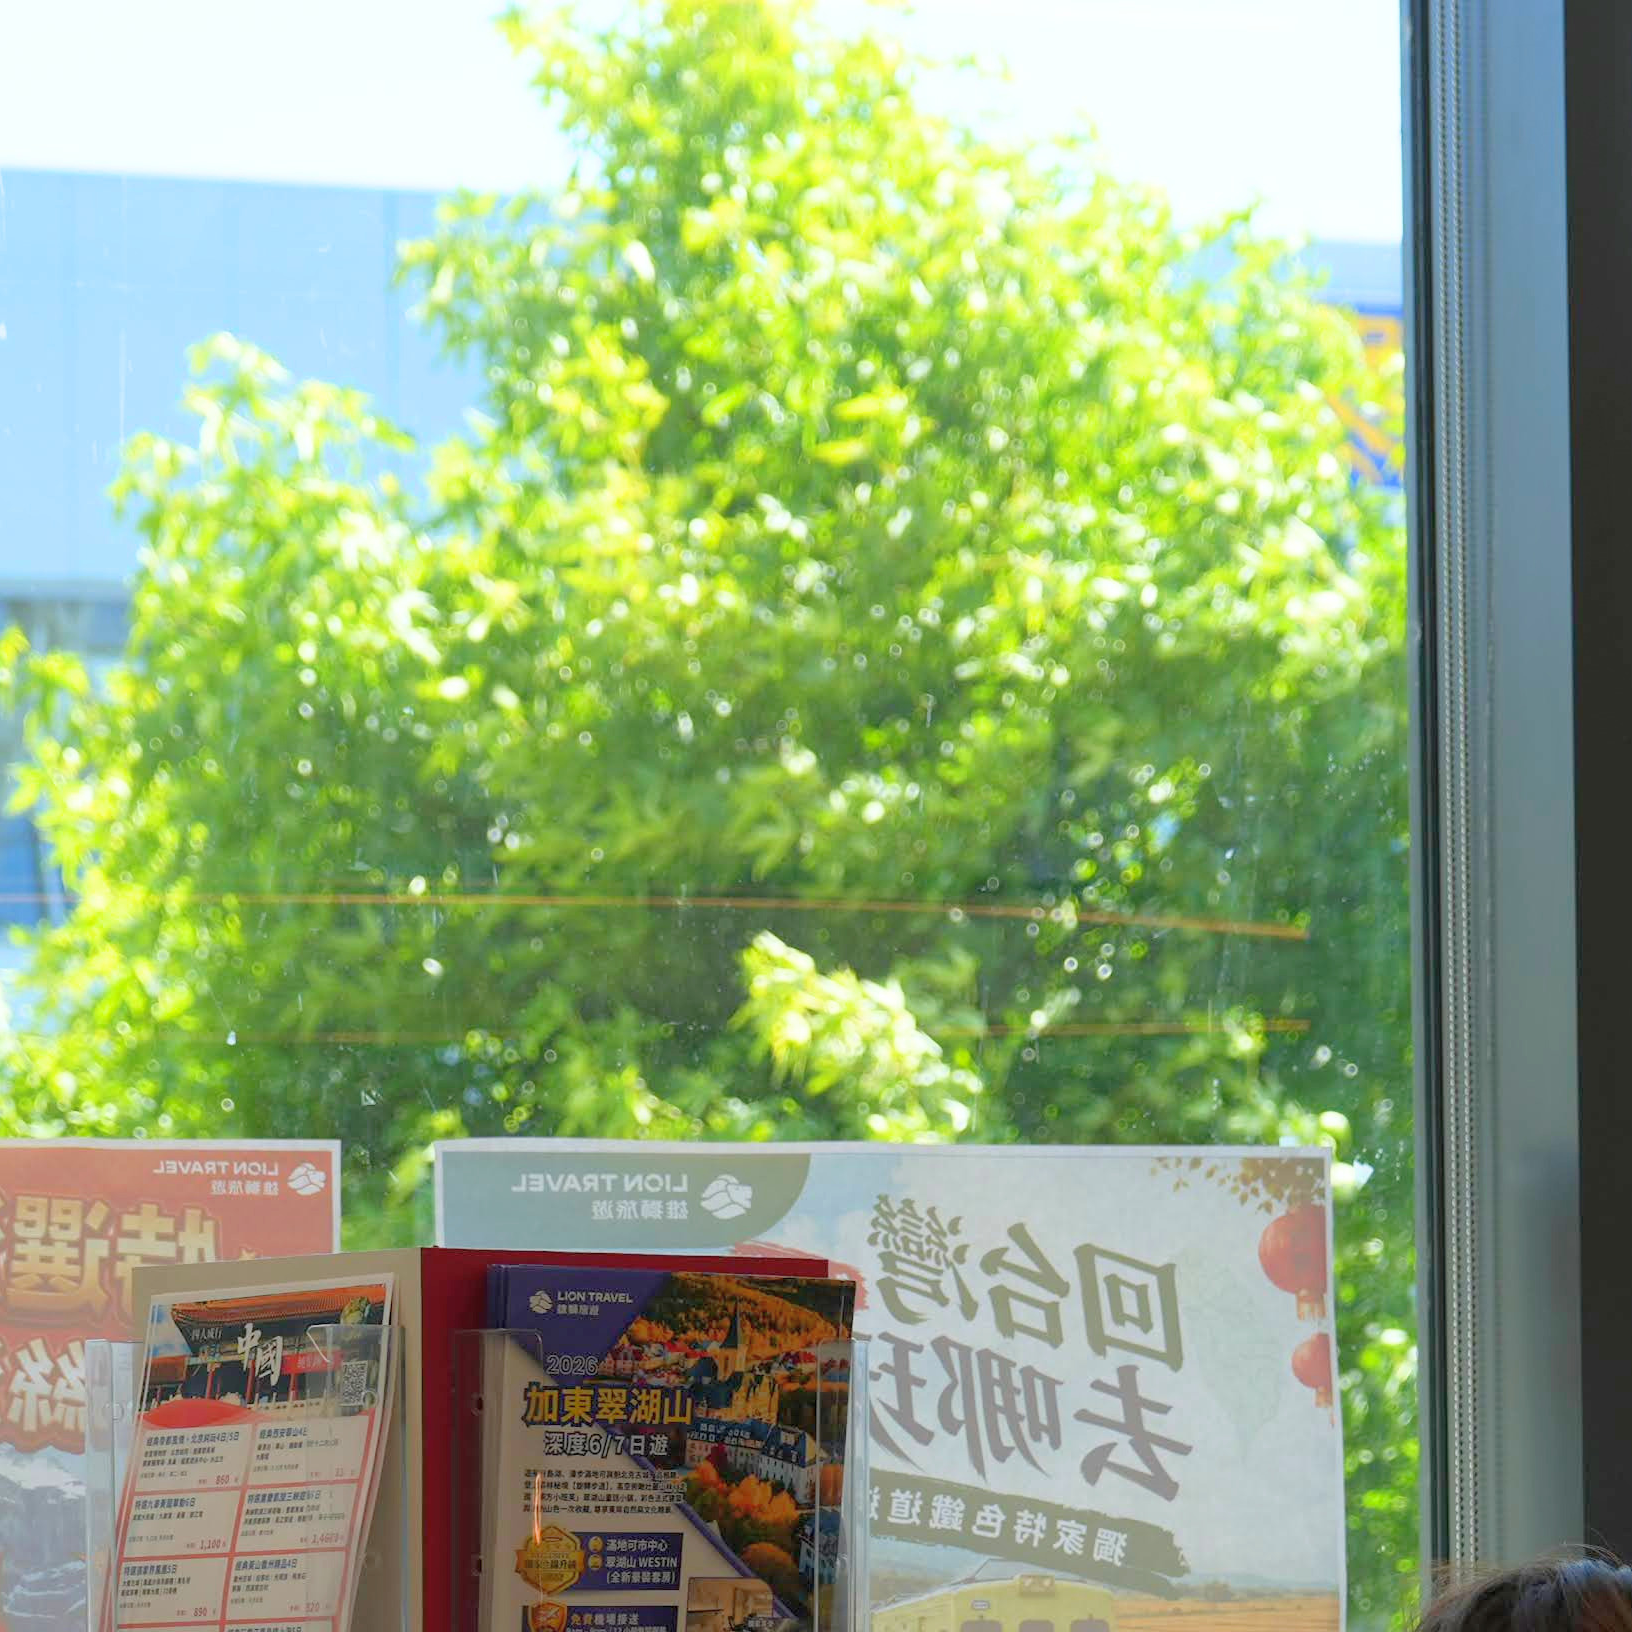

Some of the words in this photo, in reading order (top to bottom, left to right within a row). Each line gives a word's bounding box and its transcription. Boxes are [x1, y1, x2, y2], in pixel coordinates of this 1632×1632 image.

[557, 1290, 586, 1303] LION
[588, 1292, 634, 1305] TRAVEL
[237, 1322, 284, 1387] 中國
[545, 1354, 599, 1377] 2026
[524, 1386, 694, 1427] 加東翠湖山
[543, 1430, 669, 1458] 深度6/7日遊
[638, 1556, 678, 1568] WESTIN
